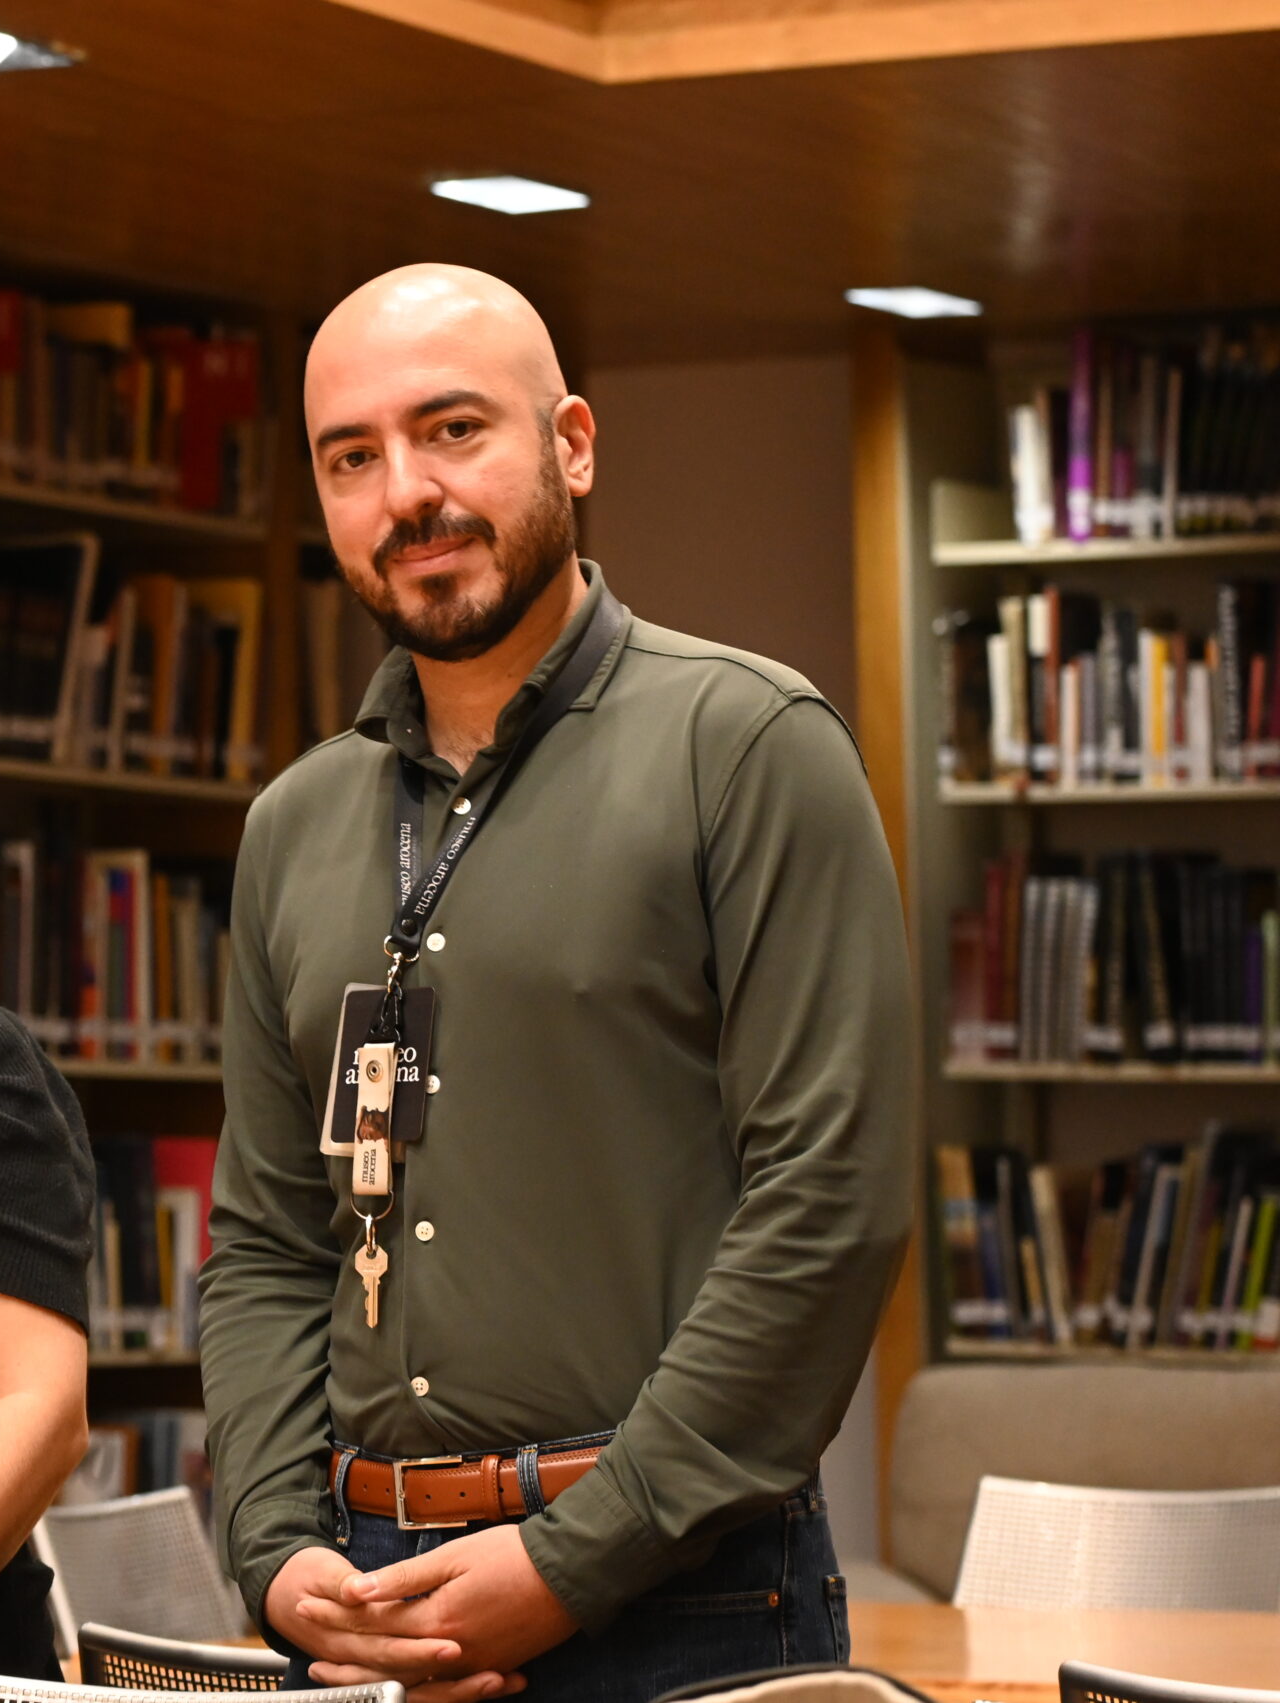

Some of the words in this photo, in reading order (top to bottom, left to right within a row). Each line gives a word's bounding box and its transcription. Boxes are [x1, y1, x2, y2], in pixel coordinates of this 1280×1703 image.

[400, 822, 411, 869] arocena
[446, 816, 477, 860] museo
[413, 862, 450, 915] arocena
